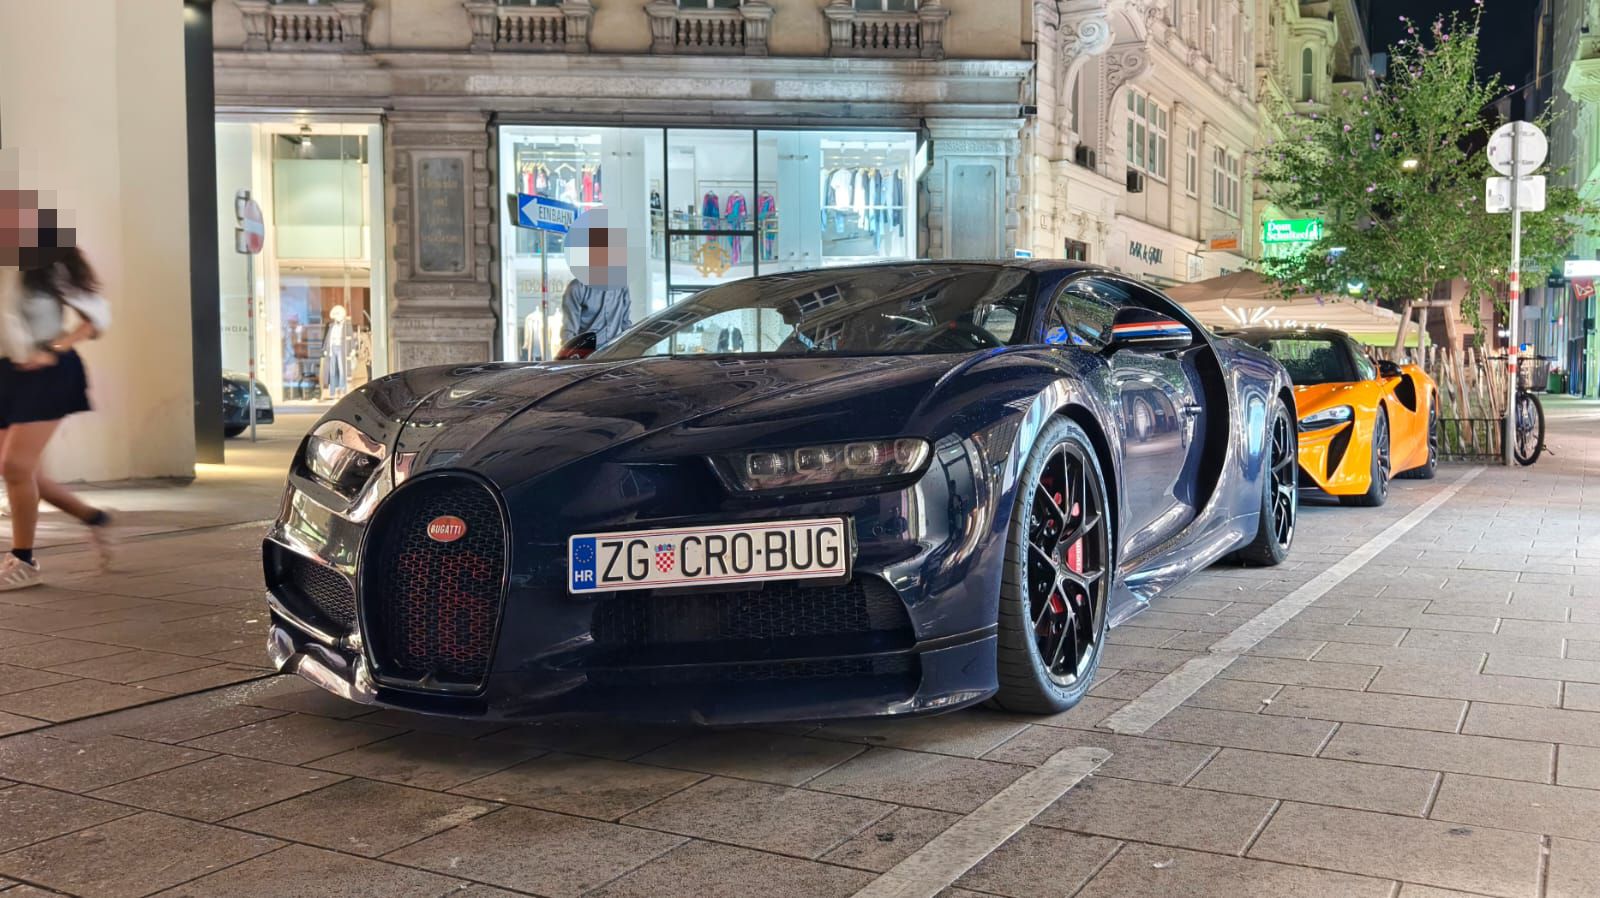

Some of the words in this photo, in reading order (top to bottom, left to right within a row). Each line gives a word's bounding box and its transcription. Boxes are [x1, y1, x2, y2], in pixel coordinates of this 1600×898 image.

[538, 206, 573, 226] EINBAHN
[1129, 240, 1143, 260] BAR
[430, 523, 462, 535] BUGATTI
[602, 539, 649, 582] ZG
[574, 568, 594, 583] HR
